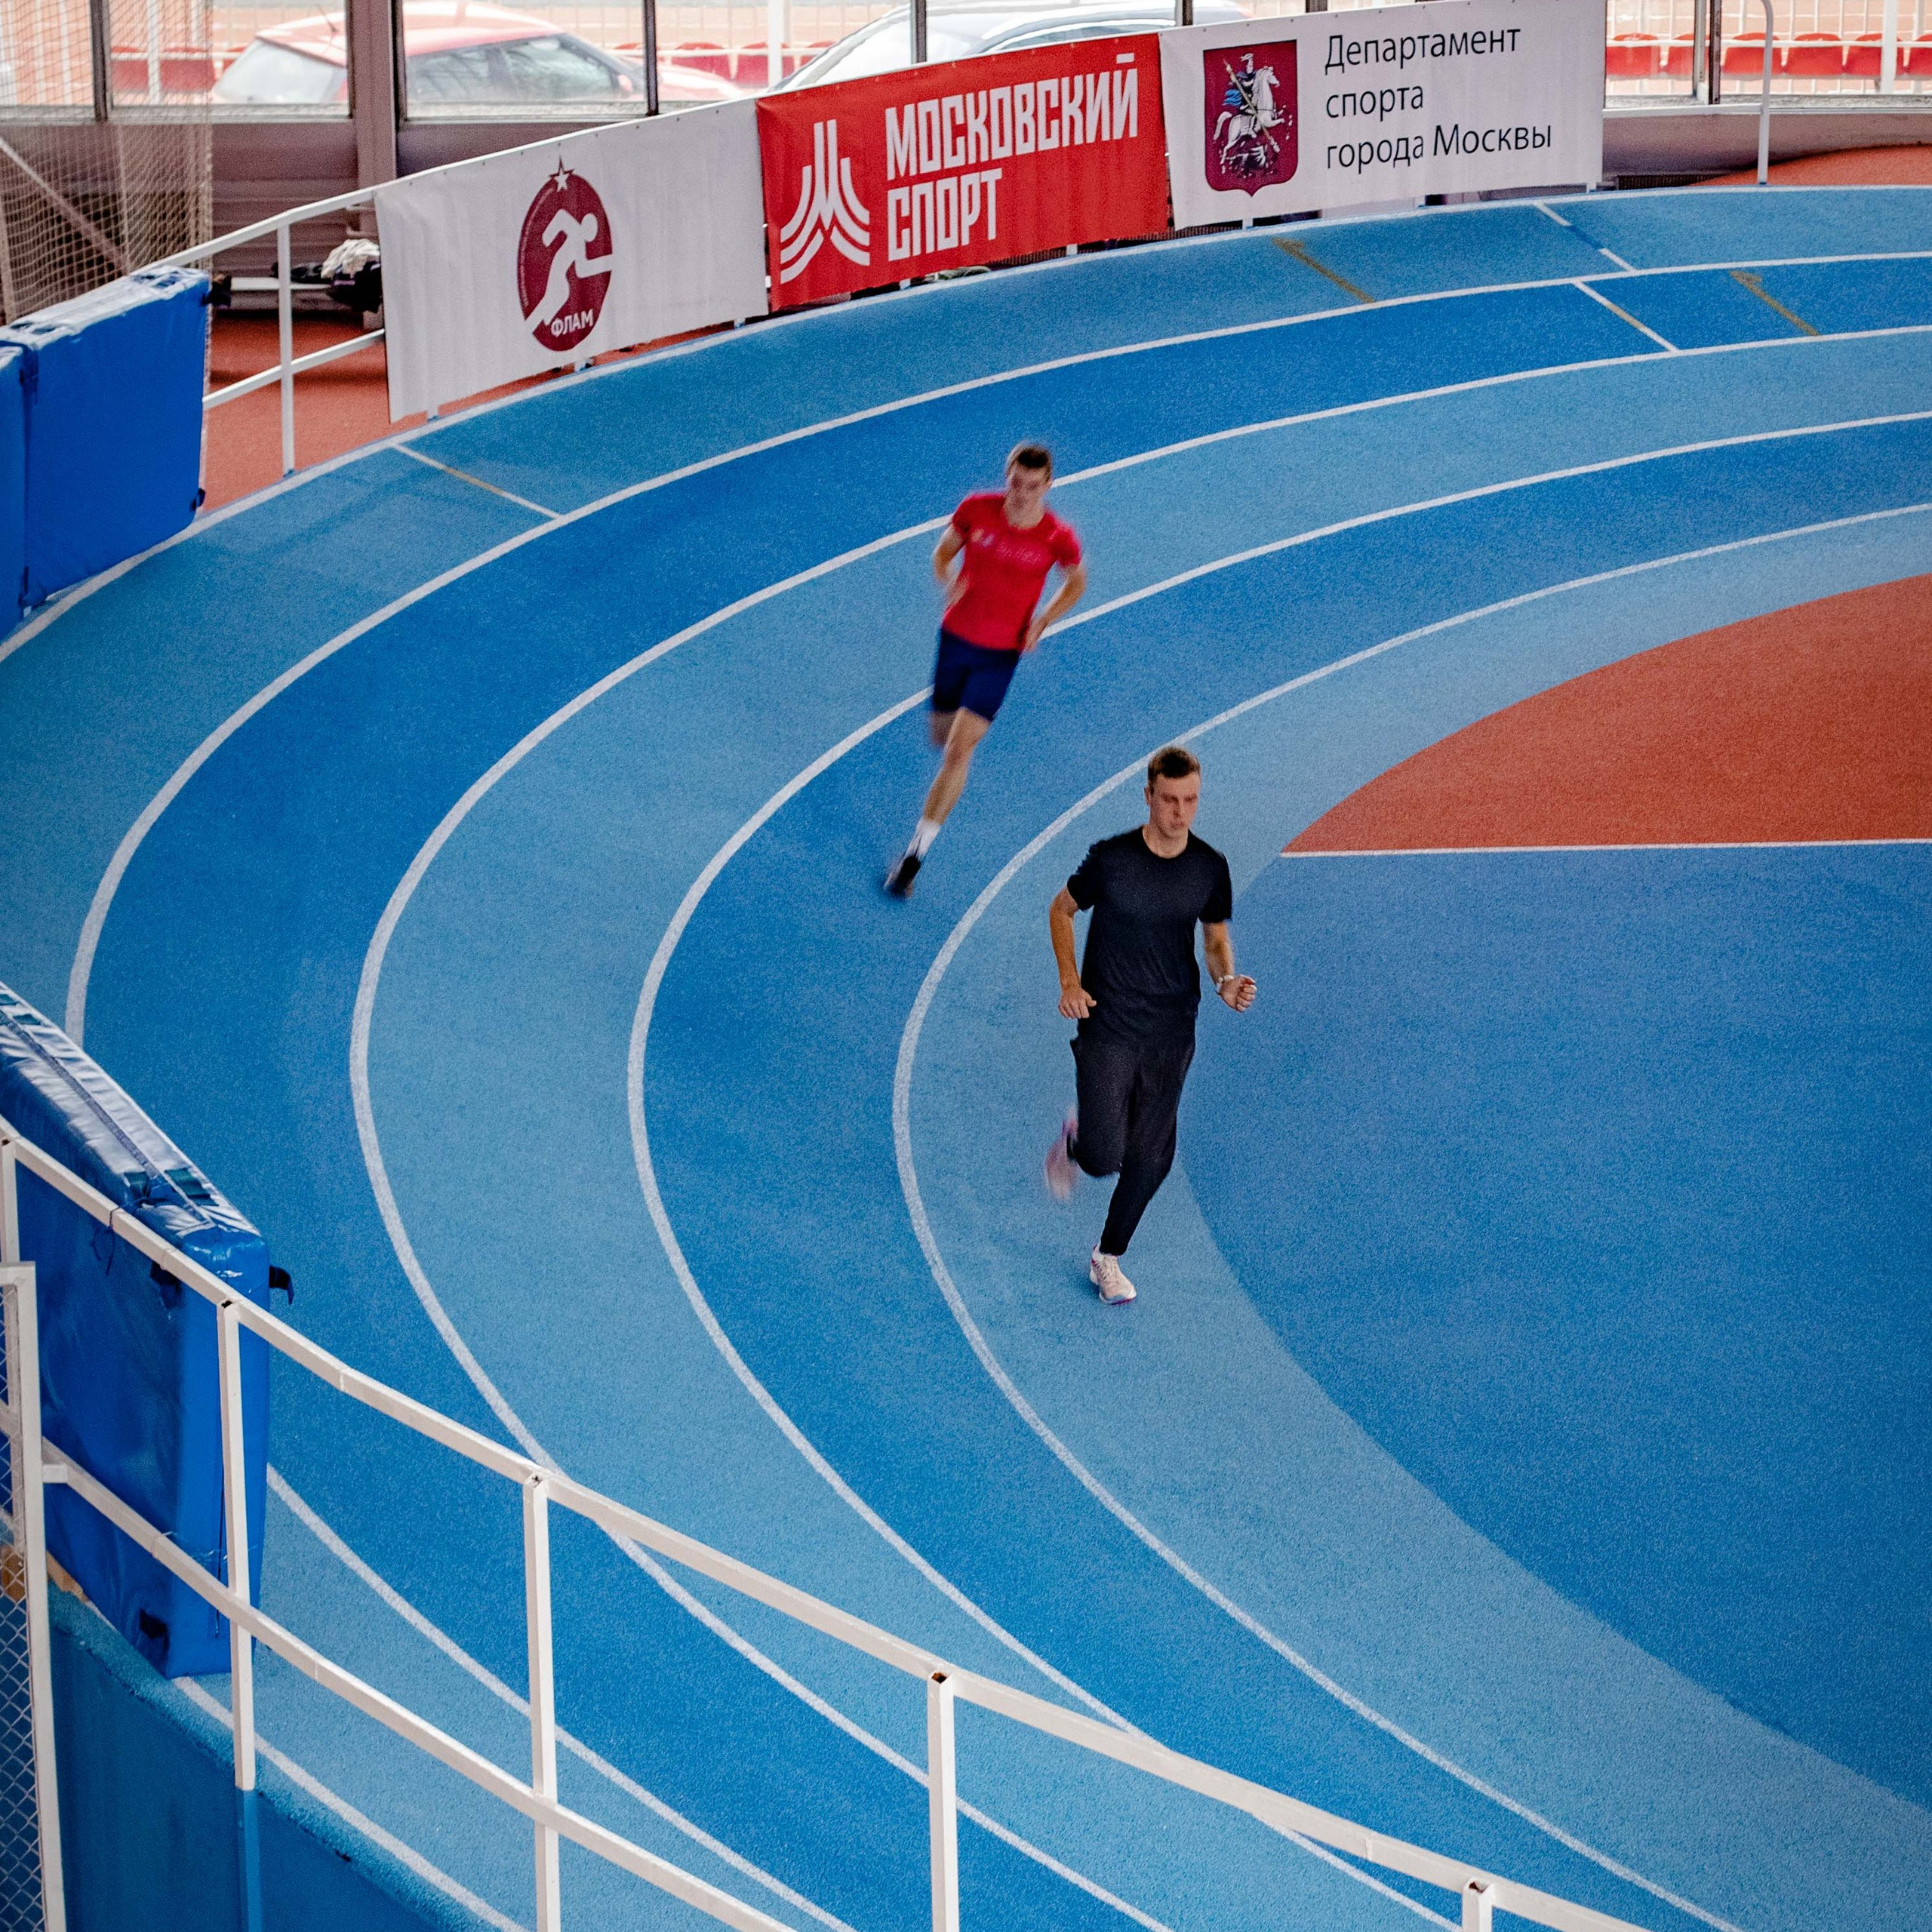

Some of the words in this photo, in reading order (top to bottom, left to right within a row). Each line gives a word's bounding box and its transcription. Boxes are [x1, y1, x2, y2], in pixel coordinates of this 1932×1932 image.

[1324, 28, 1521, 75] Департамент
[884, 53, 1138, 181] МОСКОВСКИЙ
[1325, 85, 1424, 122] спорта
[1327, 134, 1424, 174] города
[1432, 124, 1552, 156] Москвы
[887, 168, 1003, 262] СПОРТ
[550, 309, 593, 337] ФЛАМ
